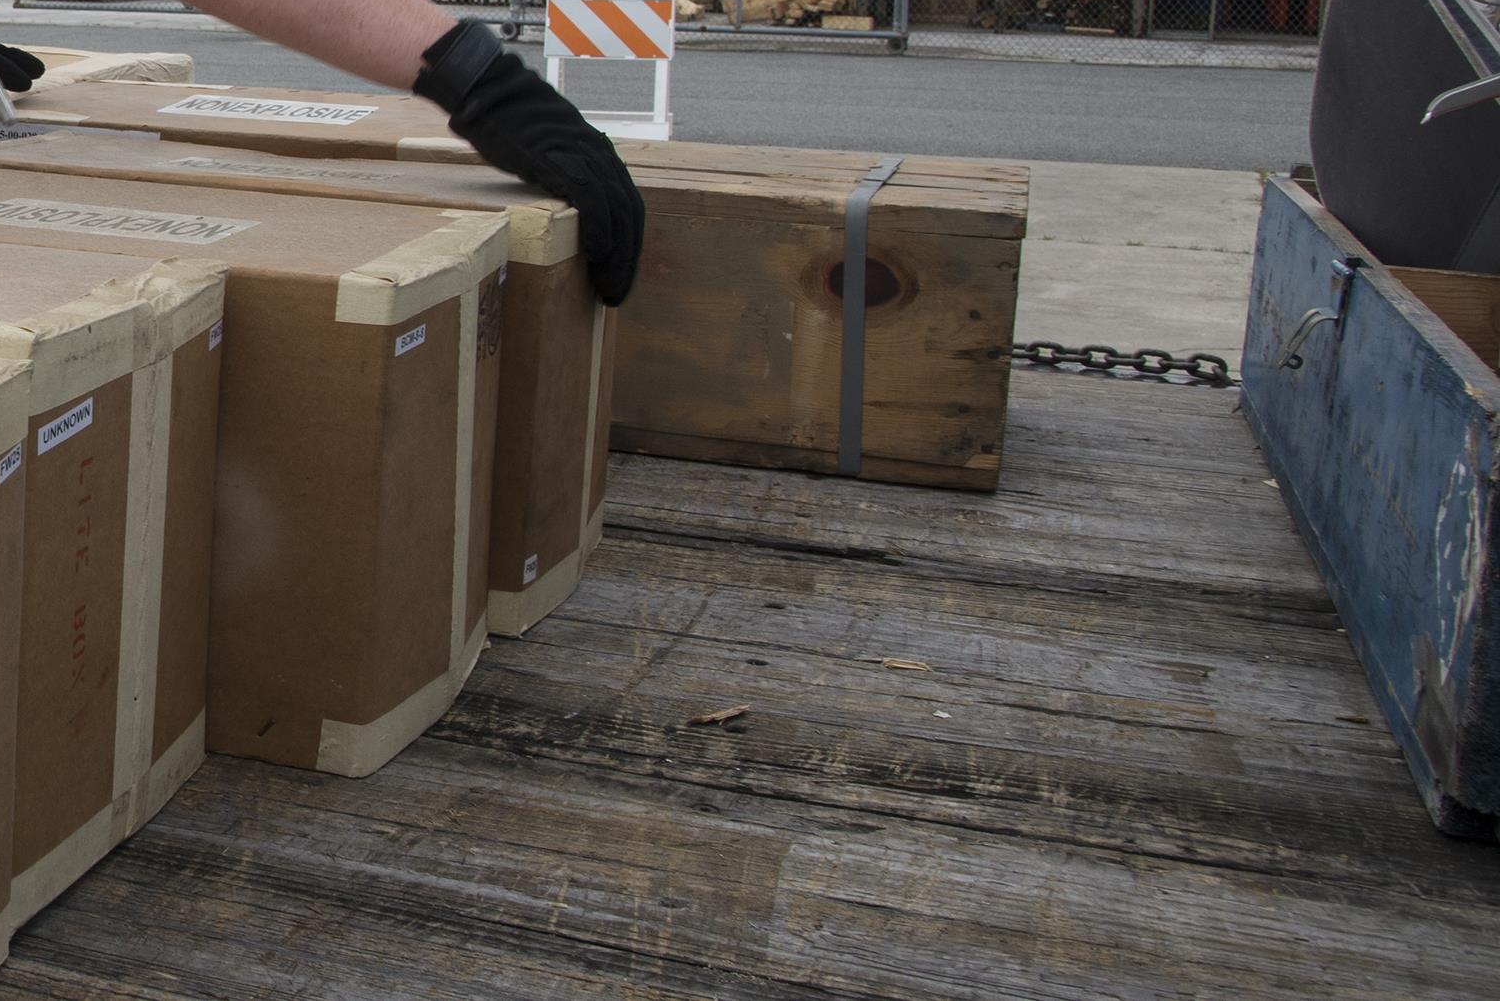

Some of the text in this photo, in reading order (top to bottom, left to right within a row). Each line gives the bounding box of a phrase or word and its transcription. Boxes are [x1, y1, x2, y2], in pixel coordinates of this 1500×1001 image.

[177, 98, 374, 121] NONEXPLOSIVE
[43, 403, 91, 444] UNKNOWN
[0, 446, 21, 477] FW25
